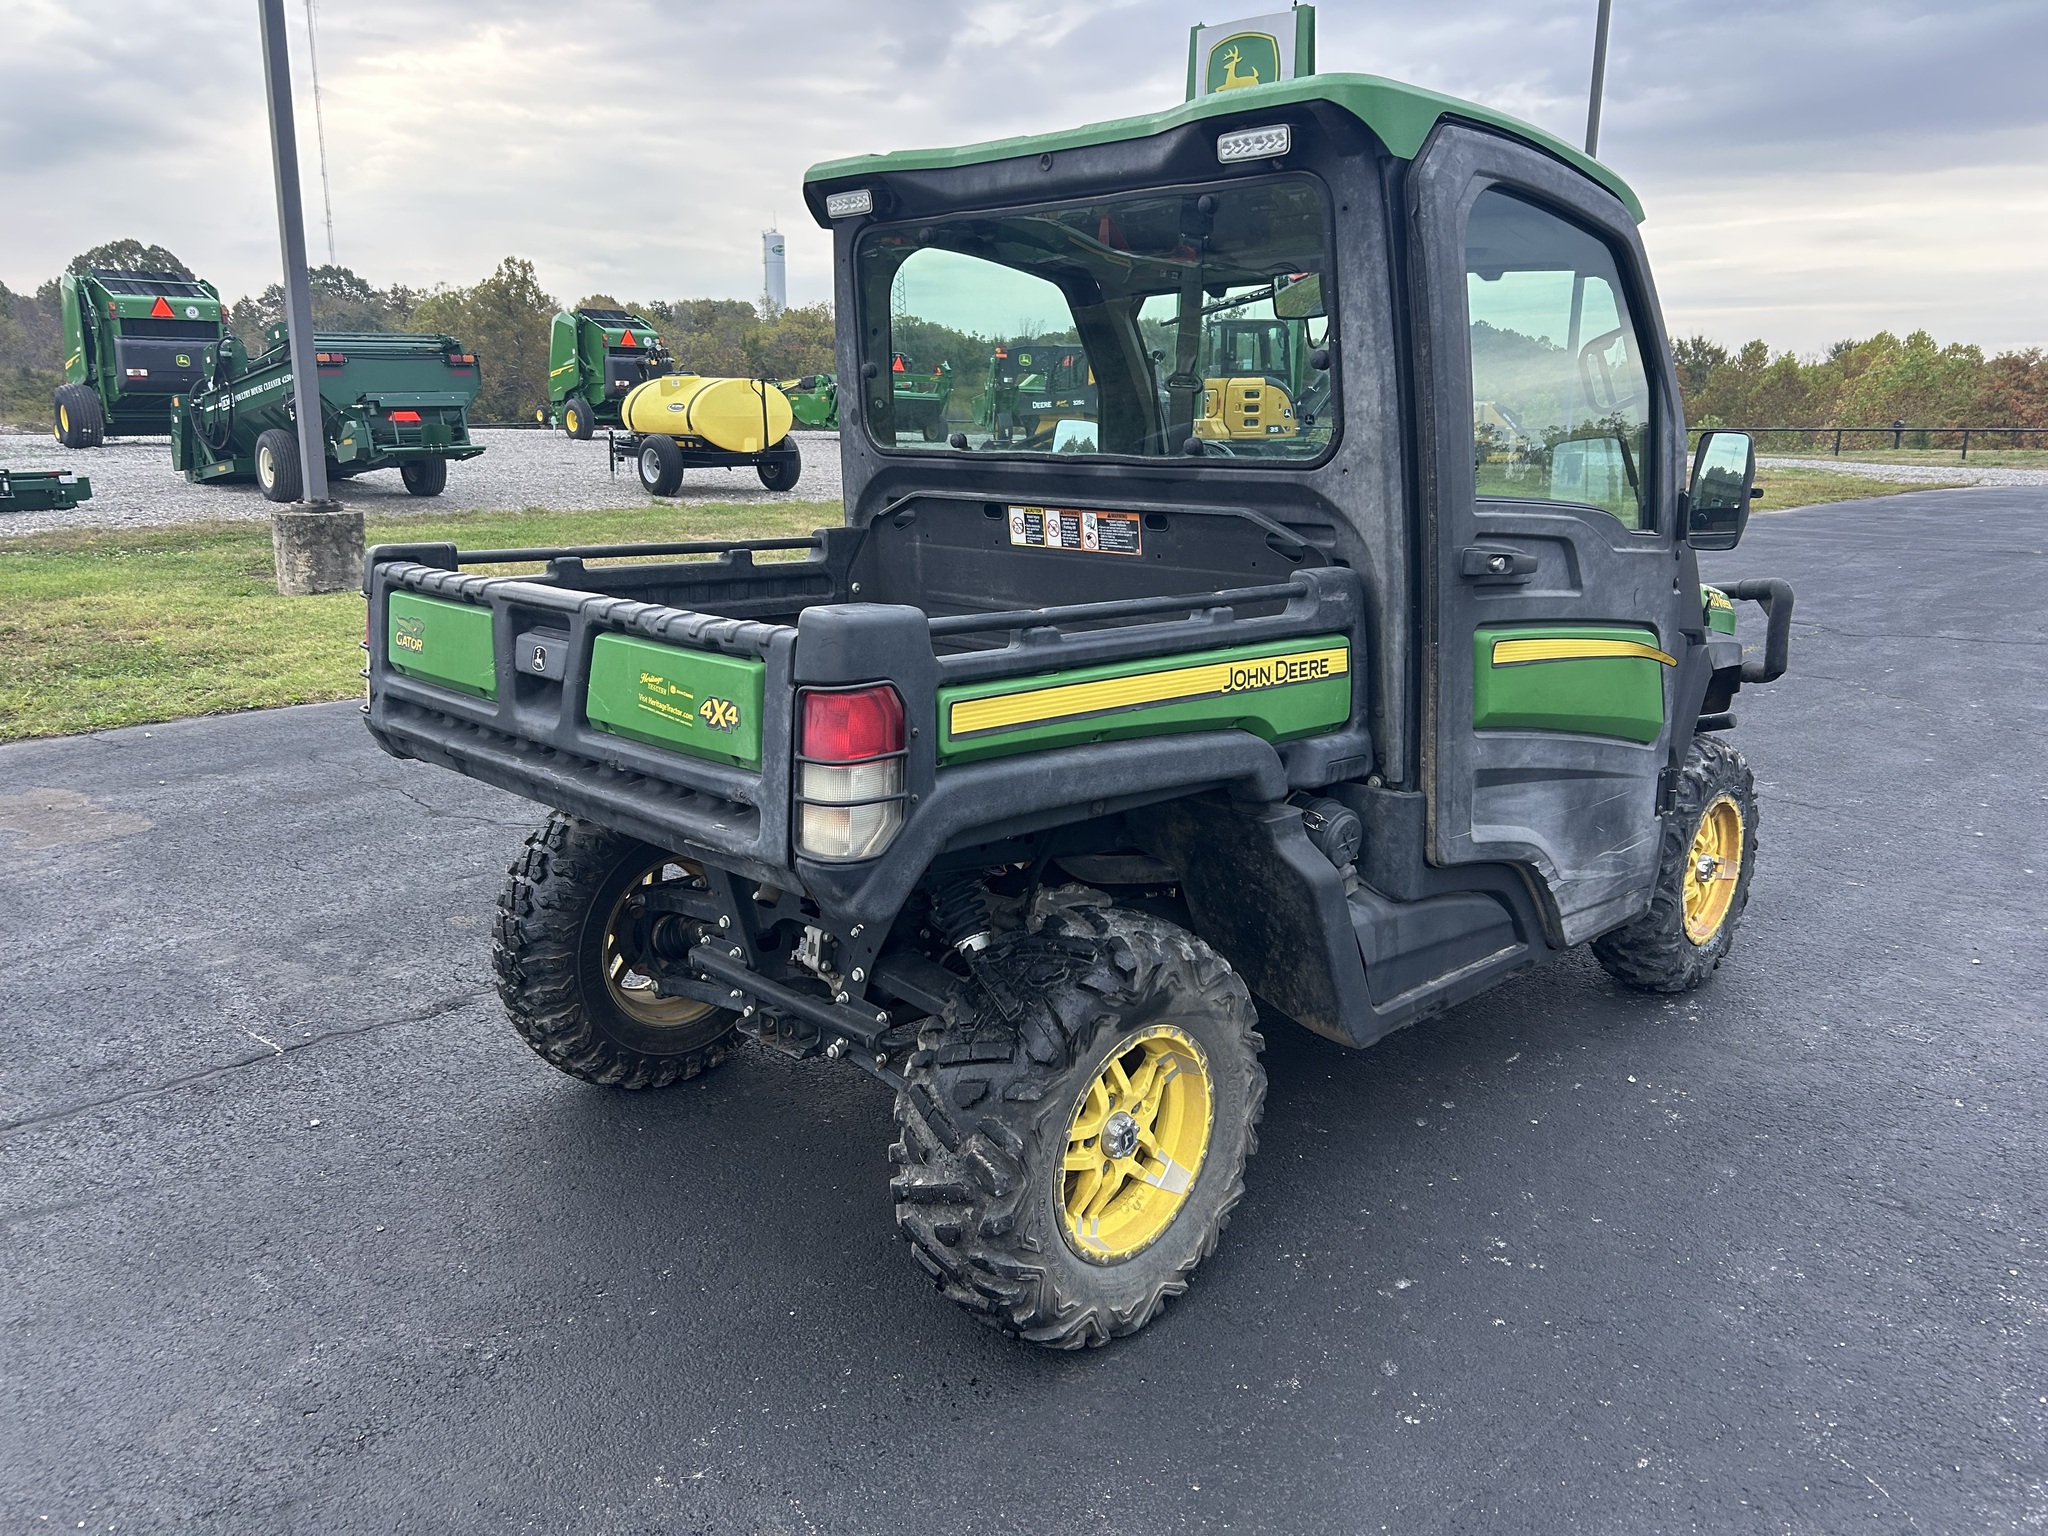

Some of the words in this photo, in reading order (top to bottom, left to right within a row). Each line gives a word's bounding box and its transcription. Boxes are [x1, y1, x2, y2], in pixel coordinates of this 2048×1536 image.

[235, 392, 250, 402] POULTRY
[250, 384, 264, 396] HOUSE
[263, 377, 281, 391] CLEANER
[1032, 401, 1052, 409] DEERE
[395, 631, 423, 652] GATOR
[1223, 666, 1271, 690] JOHN
[1275, 658, 1330, 683] DEERE
[638, 693, 648, 703] Visit
[648, 696, 693, 720] HeritageTractor.com
[700, 698, 739, 728] 4X4
